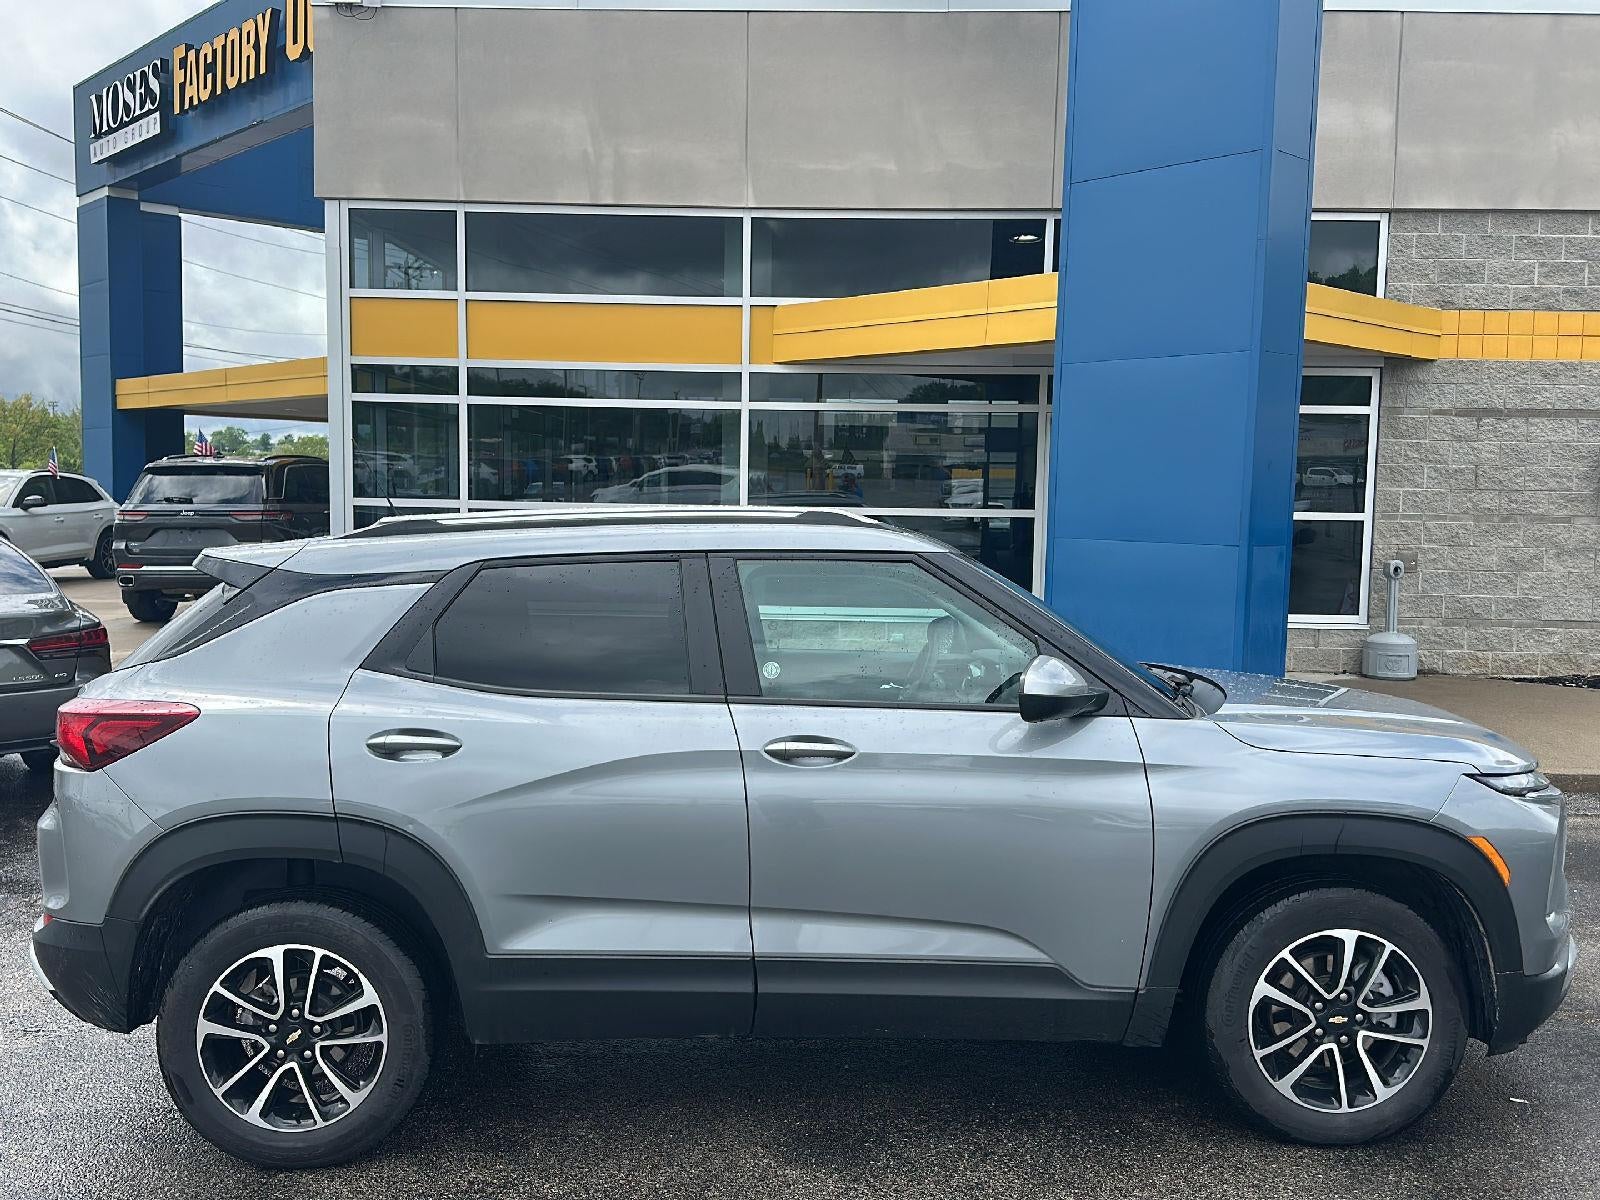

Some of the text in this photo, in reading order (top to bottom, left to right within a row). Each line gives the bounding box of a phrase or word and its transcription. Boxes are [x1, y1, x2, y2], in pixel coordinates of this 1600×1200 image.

[90, 60, 161, 138] MOSES
[173, 7, 272, 115] FACTORY
[93, 117, 158, 159] AUTO GROUP
